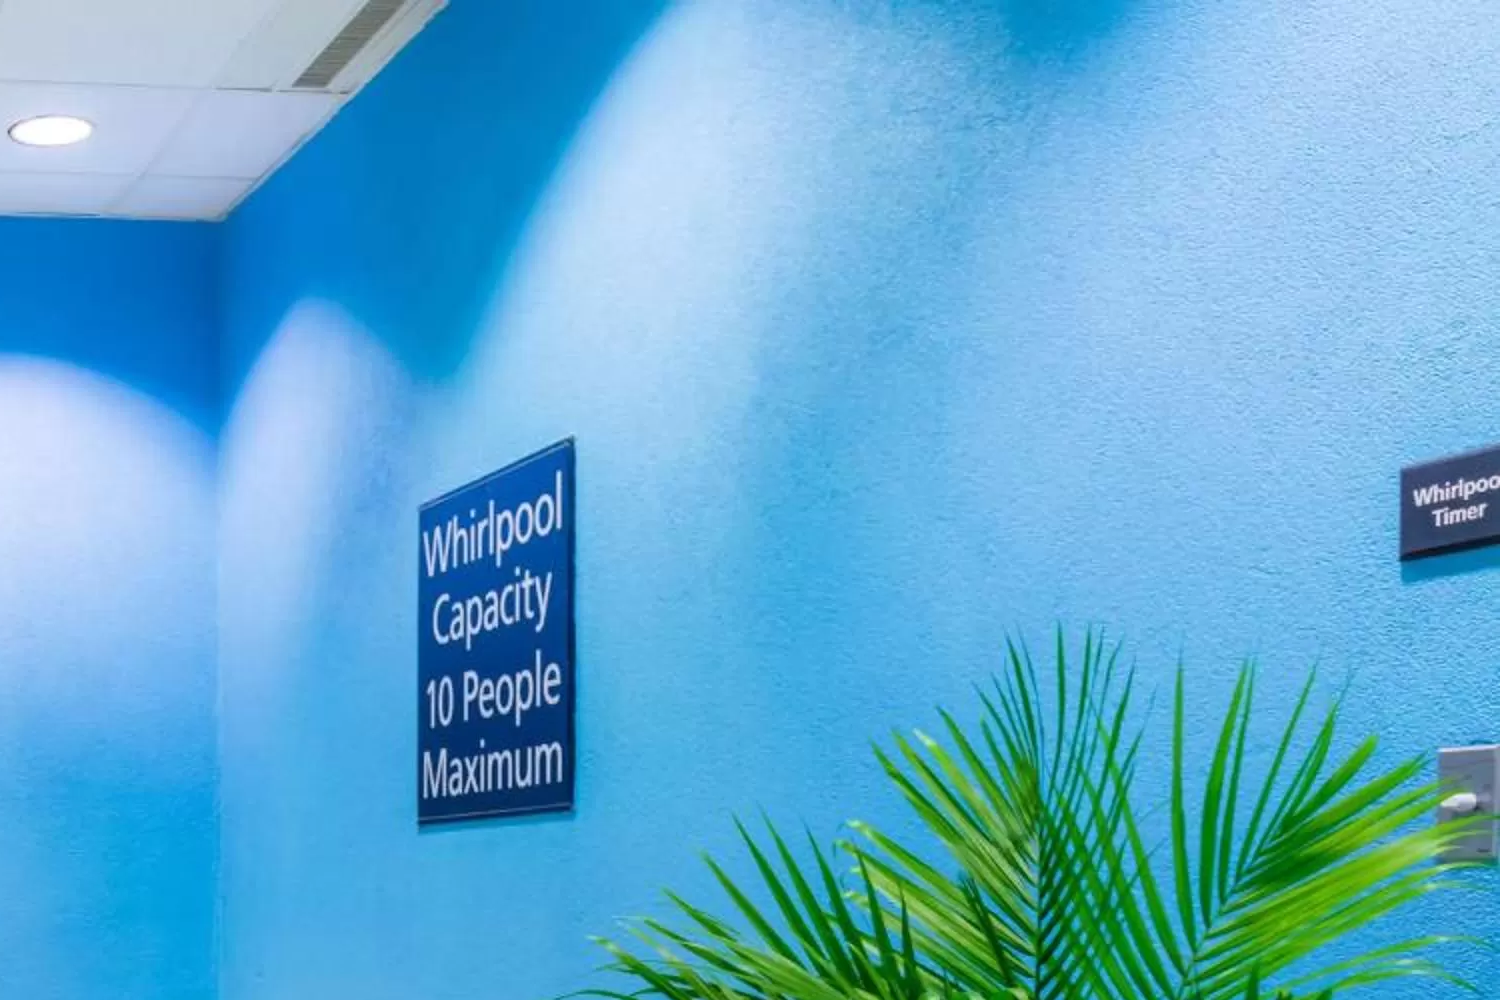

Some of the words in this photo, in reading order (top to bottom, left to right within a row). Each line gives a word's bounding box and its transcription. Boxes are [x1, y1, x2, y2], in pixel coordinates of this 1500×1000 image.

[422, 469, 563, 578] Whirlpool
[1413, 475, 1500, 507] Whirlpoo
[1431, 502, 1488, 527] Timer
[432, 566, 553, 651] Capacity
[426, 675, 454, 729] 10
[462, 649, 562, 727] People
[422, 738, 563, 799] Maximum
